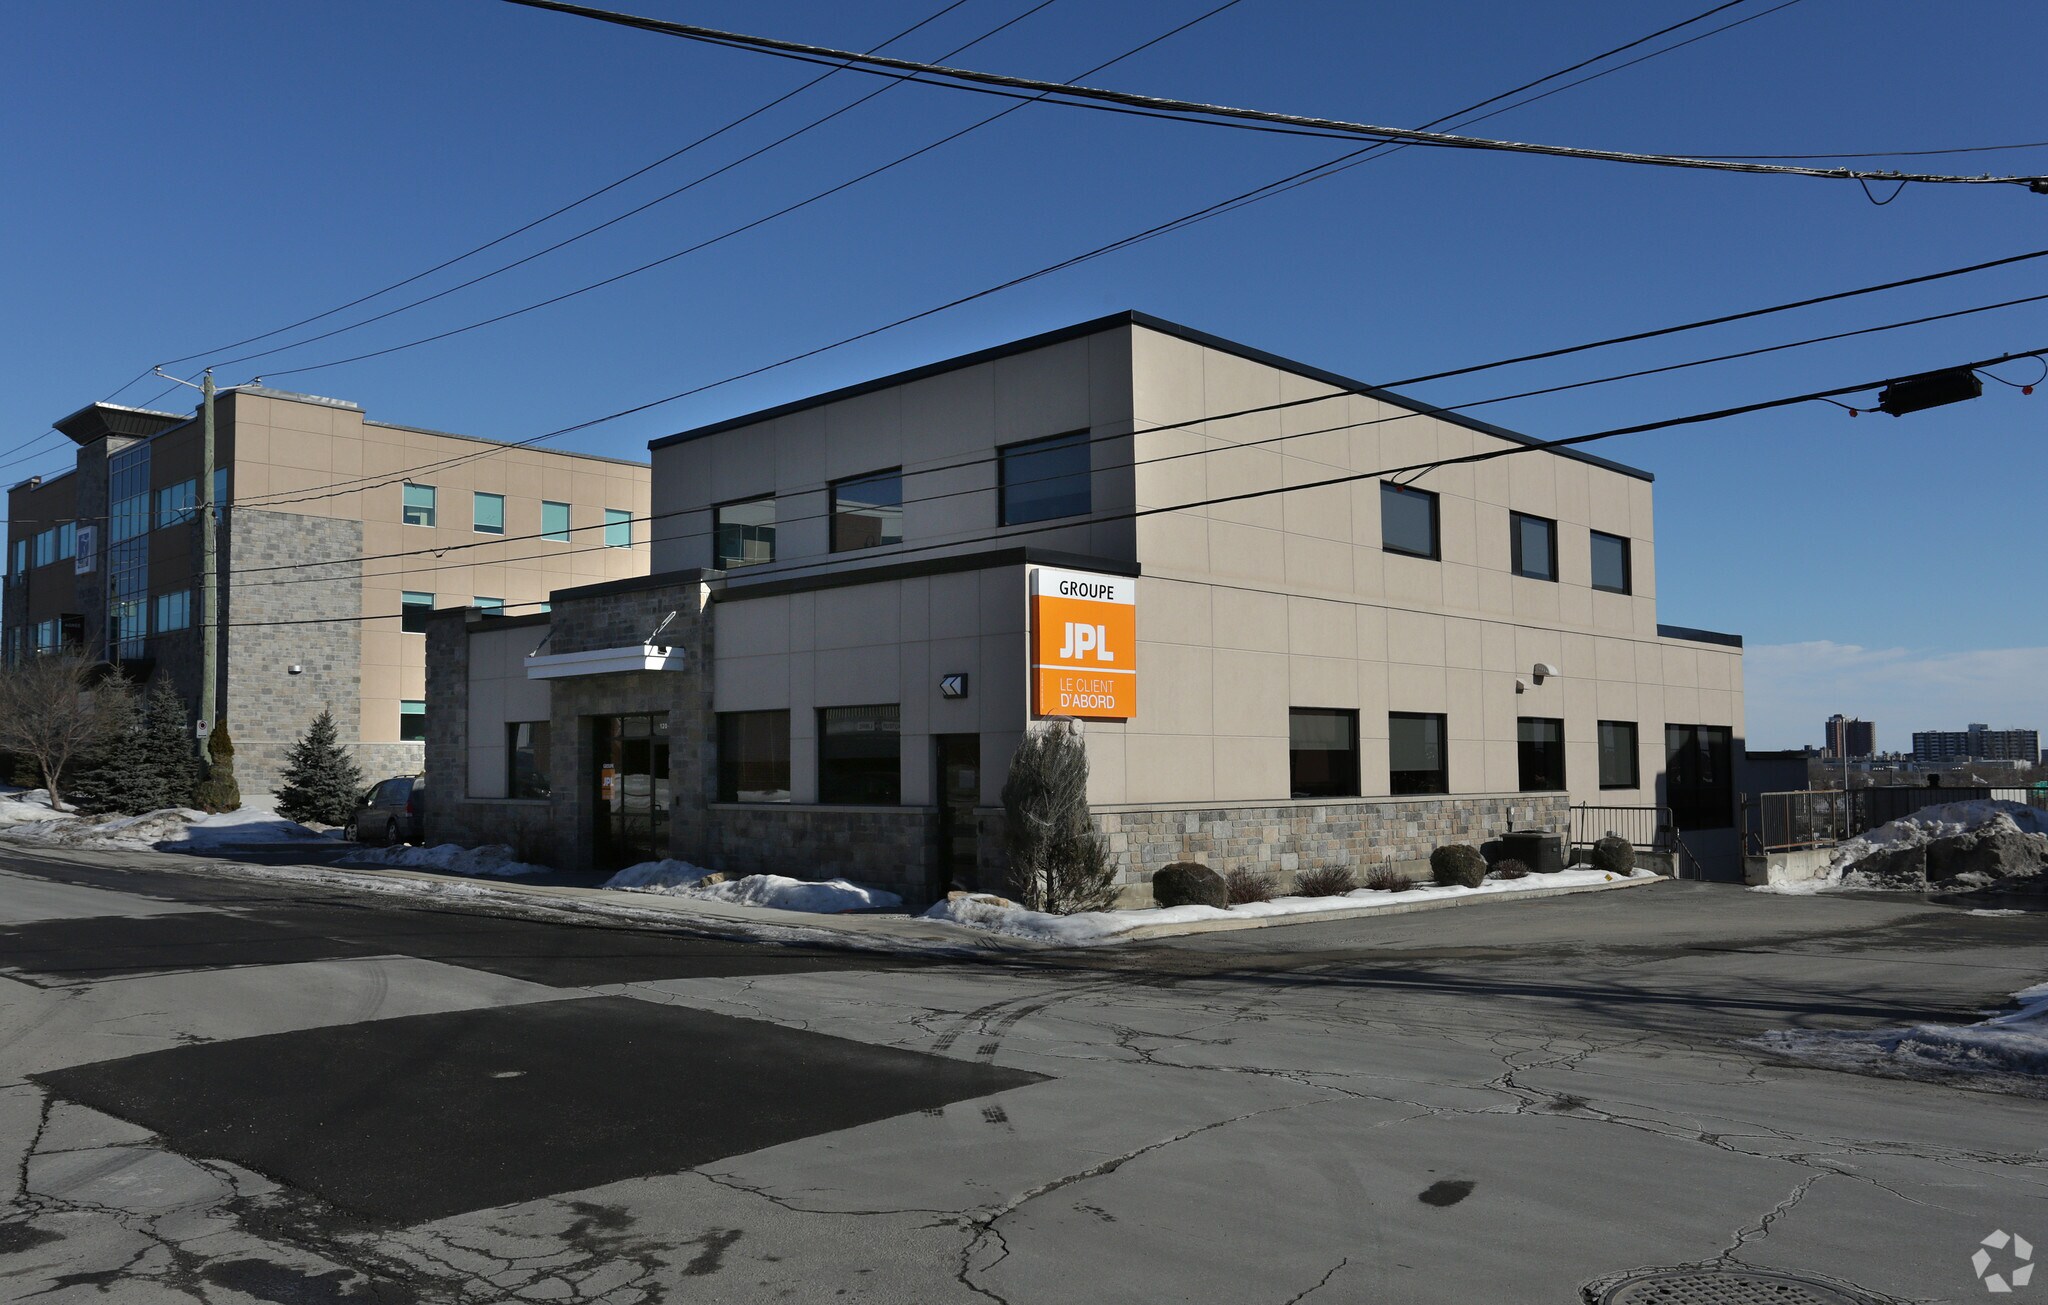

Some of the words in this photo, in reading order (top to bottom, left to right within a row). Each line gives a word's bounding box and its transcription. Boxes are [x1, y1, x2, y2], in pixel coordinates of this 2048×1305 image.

[1059, 580, 1114, 600] GROUPE
[1059, 622, 1114, 661] JPL
[1060, 678, 1073, 692] LE
[1076, 678, 1115, 693] CLIENT
[1060, 693, 1115, 709] D'ABORD
